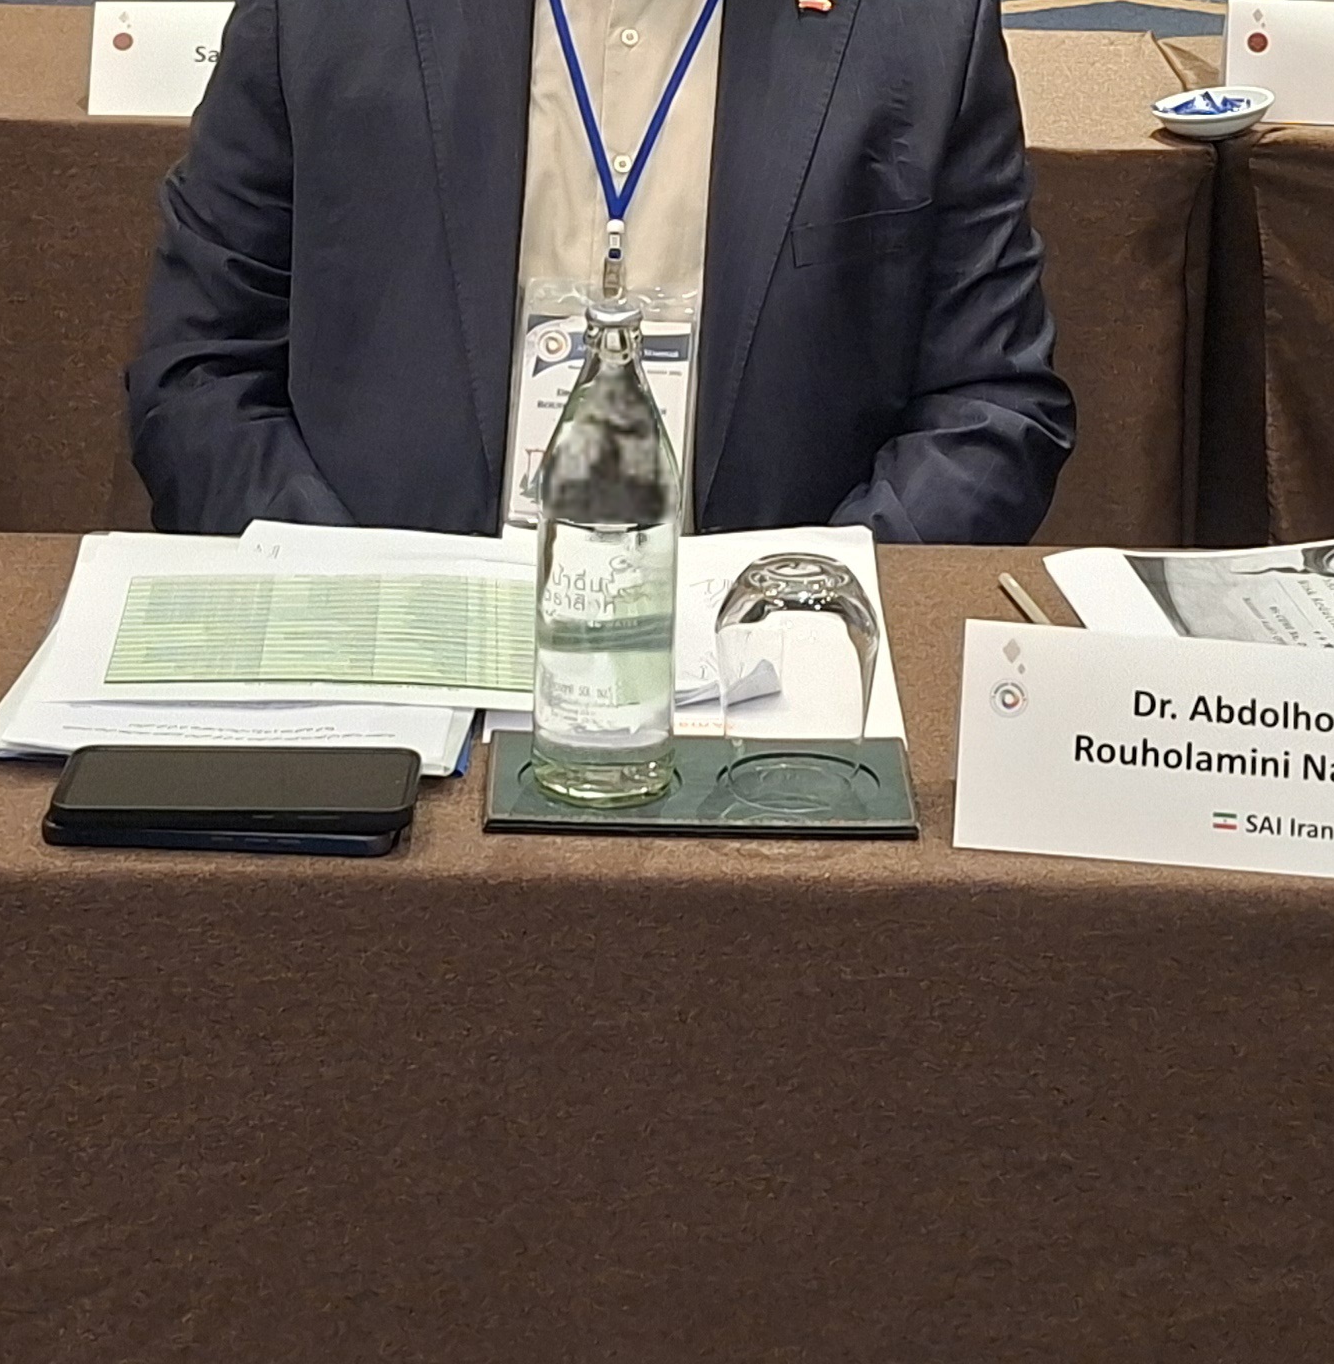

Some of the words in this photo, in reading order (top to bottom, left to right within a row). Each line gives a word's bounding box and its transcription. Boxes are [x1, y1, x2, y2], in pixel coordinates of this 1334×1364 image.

[1133, 689, 1177, 720] Dr.
[1074, 734, 1291, 779] Rouholamini
[1245, 814, 1282, 836] SAI
[1290, 817, 1334, 840] Iran
